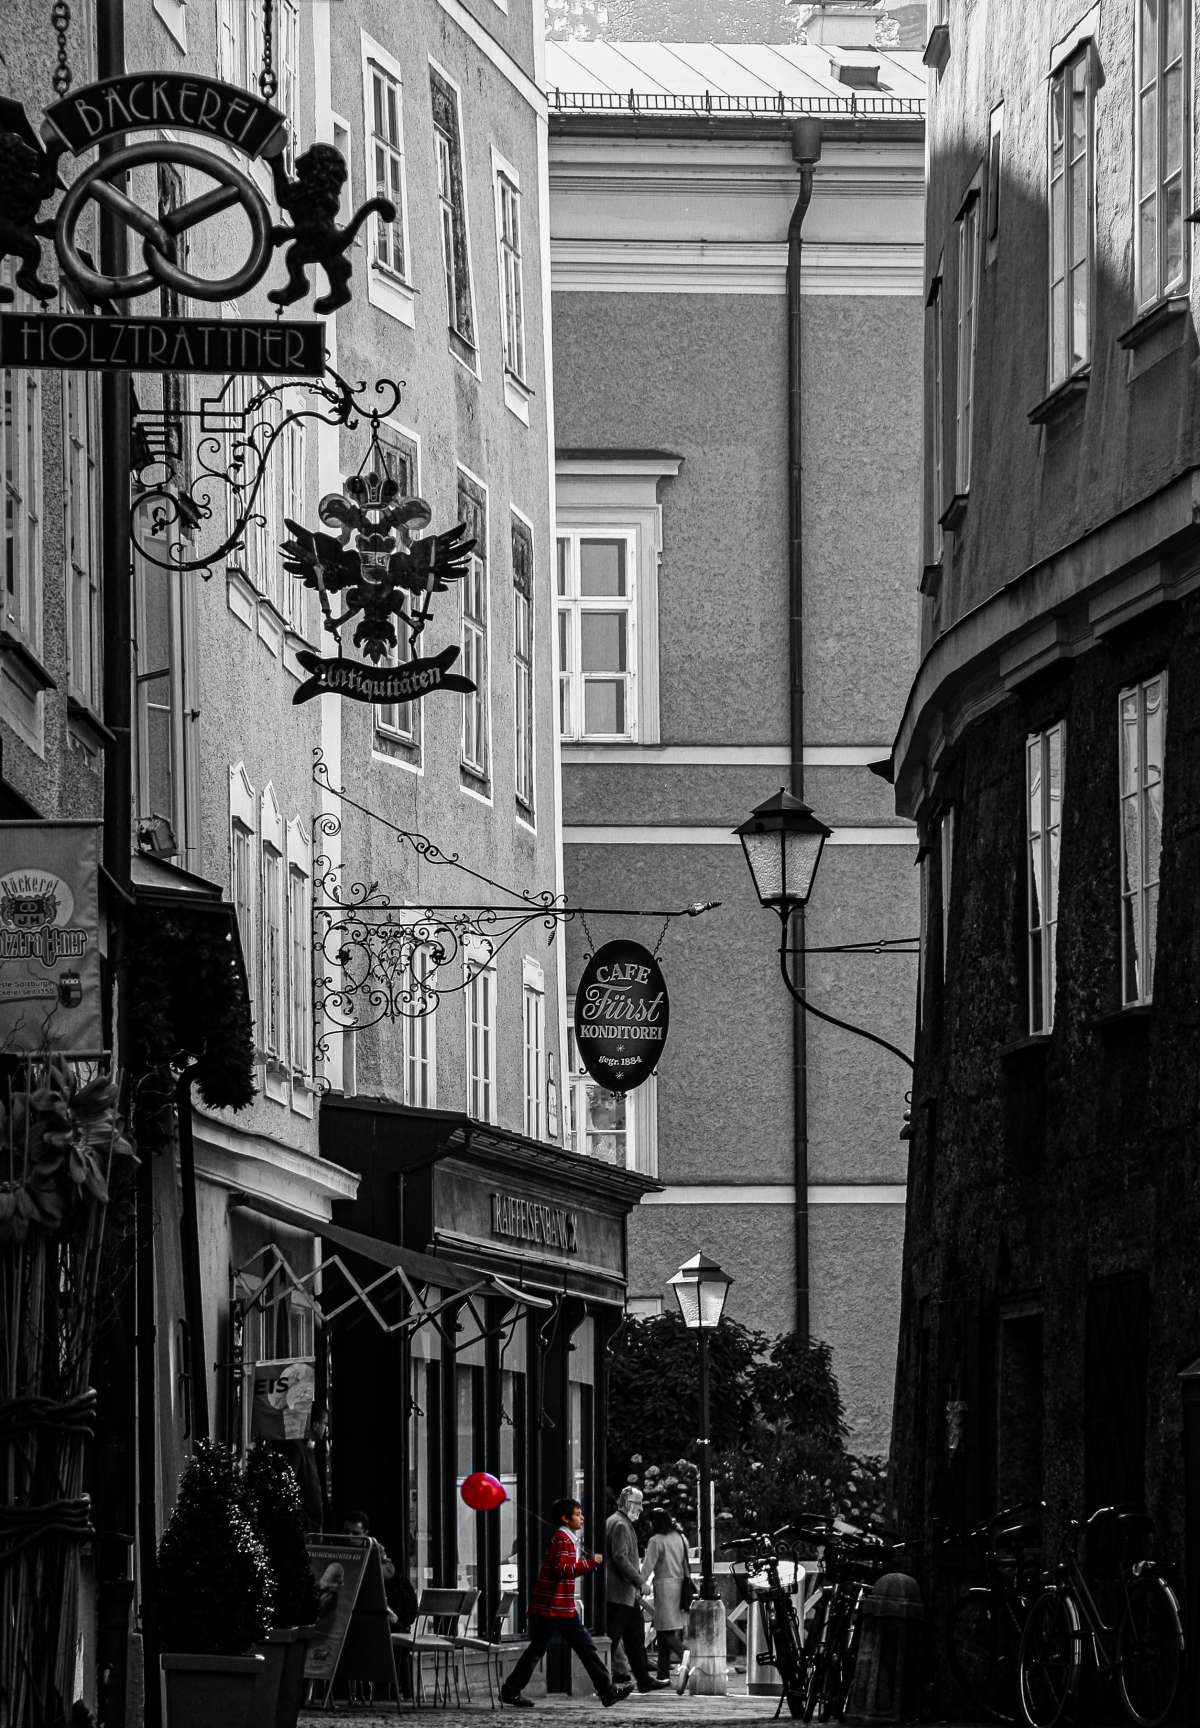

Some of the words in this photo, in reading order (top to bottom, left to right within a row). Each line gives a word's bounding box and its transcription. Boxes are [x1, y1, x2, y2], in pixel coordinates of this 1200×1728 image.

[74, 80, 259, 143] BÄCKEREI
[20, 321, 305, 368] HOLZTRATTNER
[315, 664, 441, 701] Antiquitäten
[596, 963, 652, 984] CAFE
[582, 983, 664, 1022] Fürst
[580, 1024, 663, 1040] KONDITOREI
[255, 1377, 288, 1394] EIS
